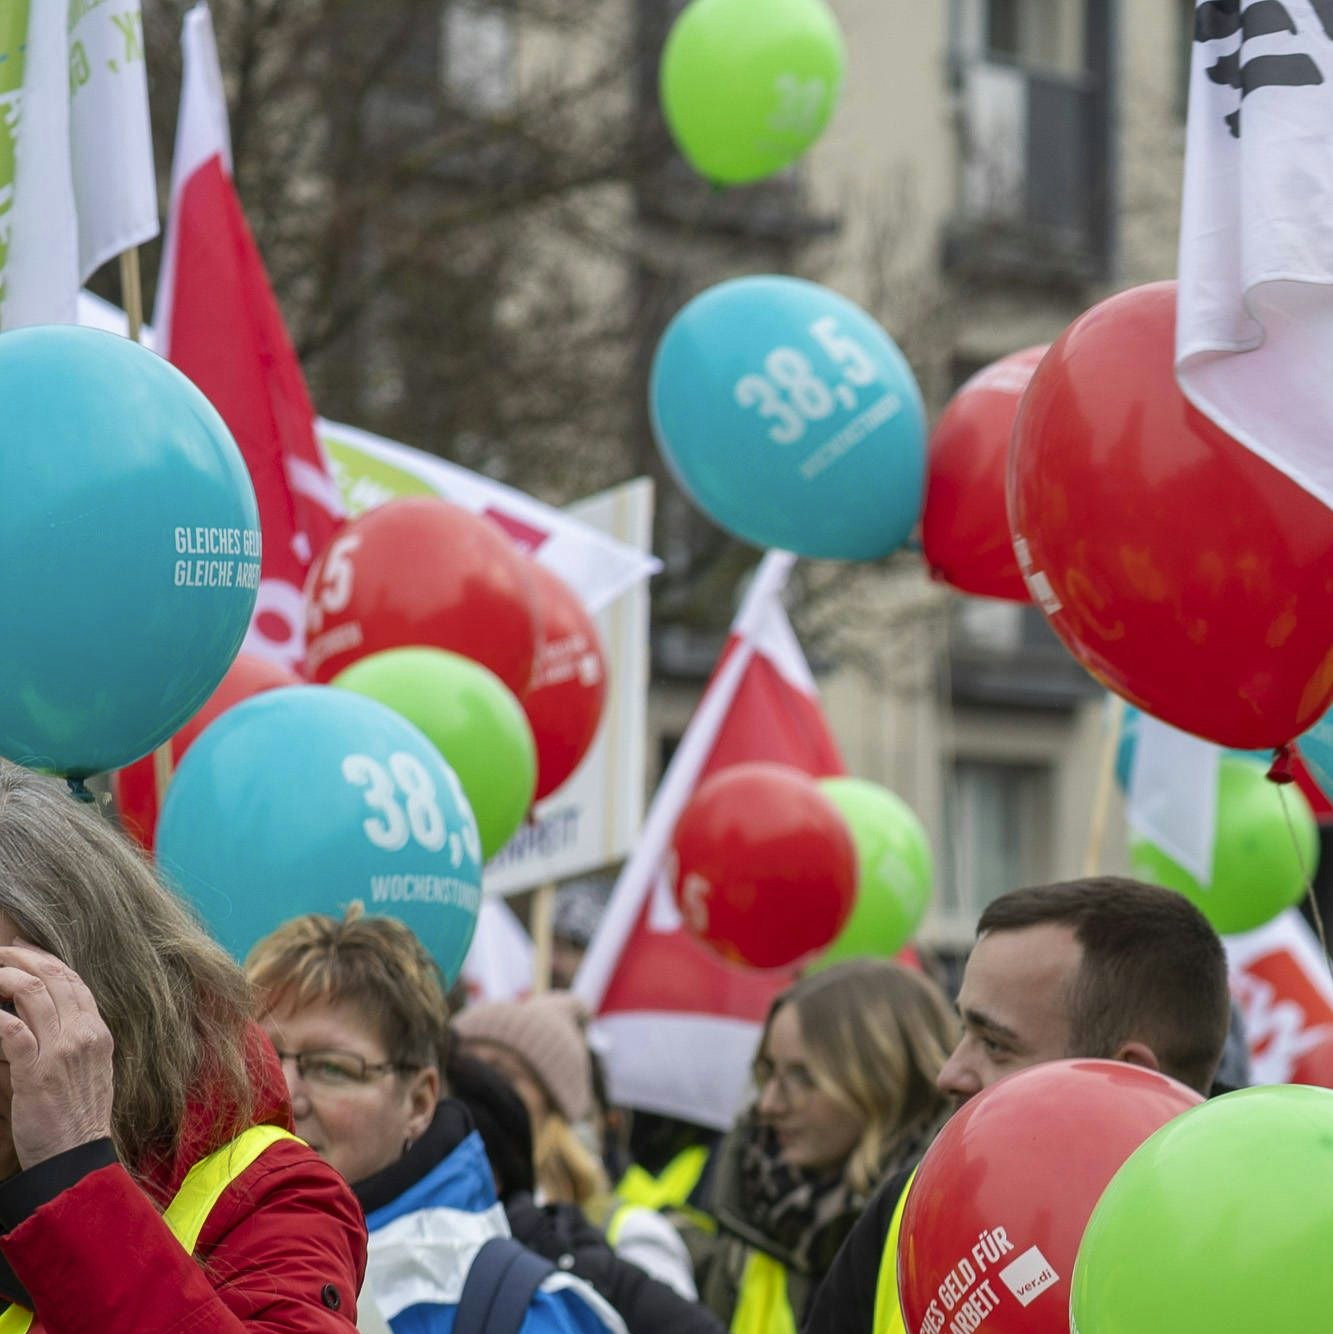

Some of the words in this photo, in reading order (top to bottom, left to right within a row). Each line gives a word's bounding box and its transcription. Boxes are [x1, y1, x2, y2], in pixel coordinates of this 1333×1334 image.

[734, 316, 877, 443] 38,5
[174, 527, 241, 556] GLEICHES
[174, 560, 234, 587] GLEICHE
[938, 1257, 977, 1311] GELD
[971, 1225, 1015, 1273] FÜR
[1016, 1268, 1053, 1297] ver.di
